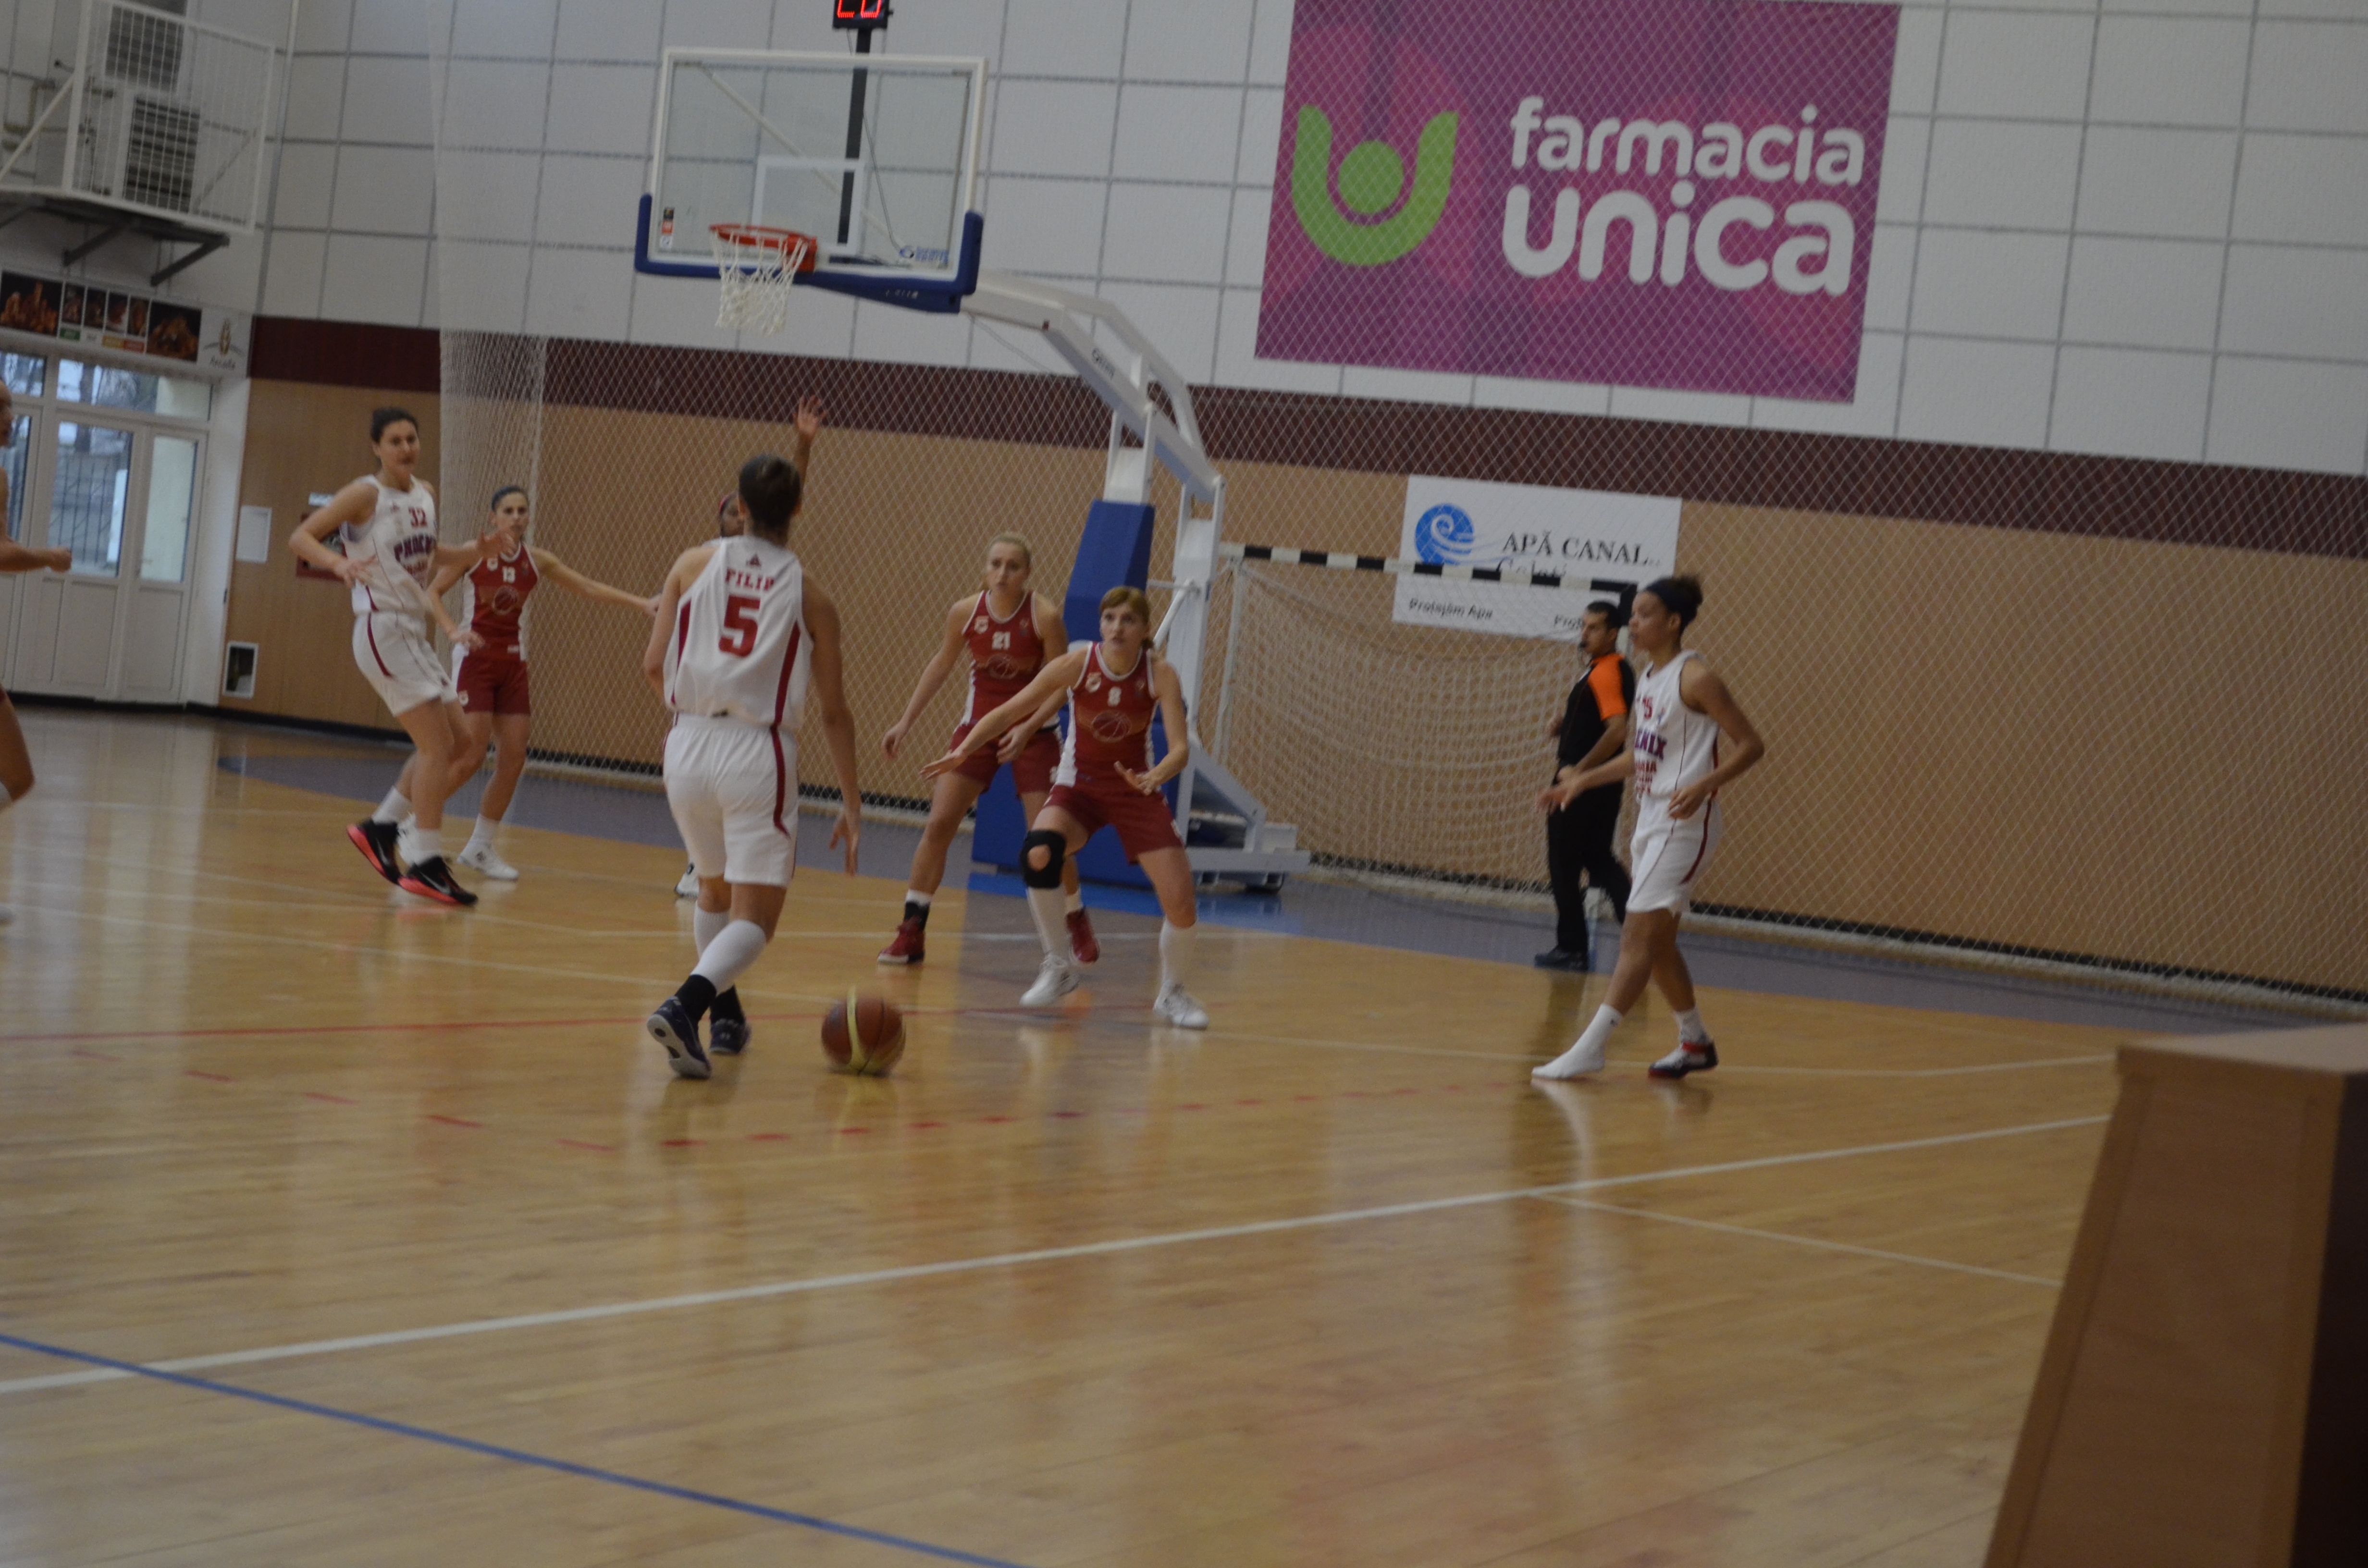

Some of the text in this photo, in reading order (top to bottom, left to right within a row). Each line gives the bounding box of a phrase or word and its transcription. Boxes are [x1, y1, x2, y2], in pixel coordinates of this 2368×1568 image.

[1510, 95, 1866, 186] farmacia
[1562, 537, 1649, 565] CANAL
[726, 568, 775, 591] FILIP
[718, 594, 761, 658] 5
[992, 631, 1011, 650] 21
[1108, 686, 1122, 706] 8
